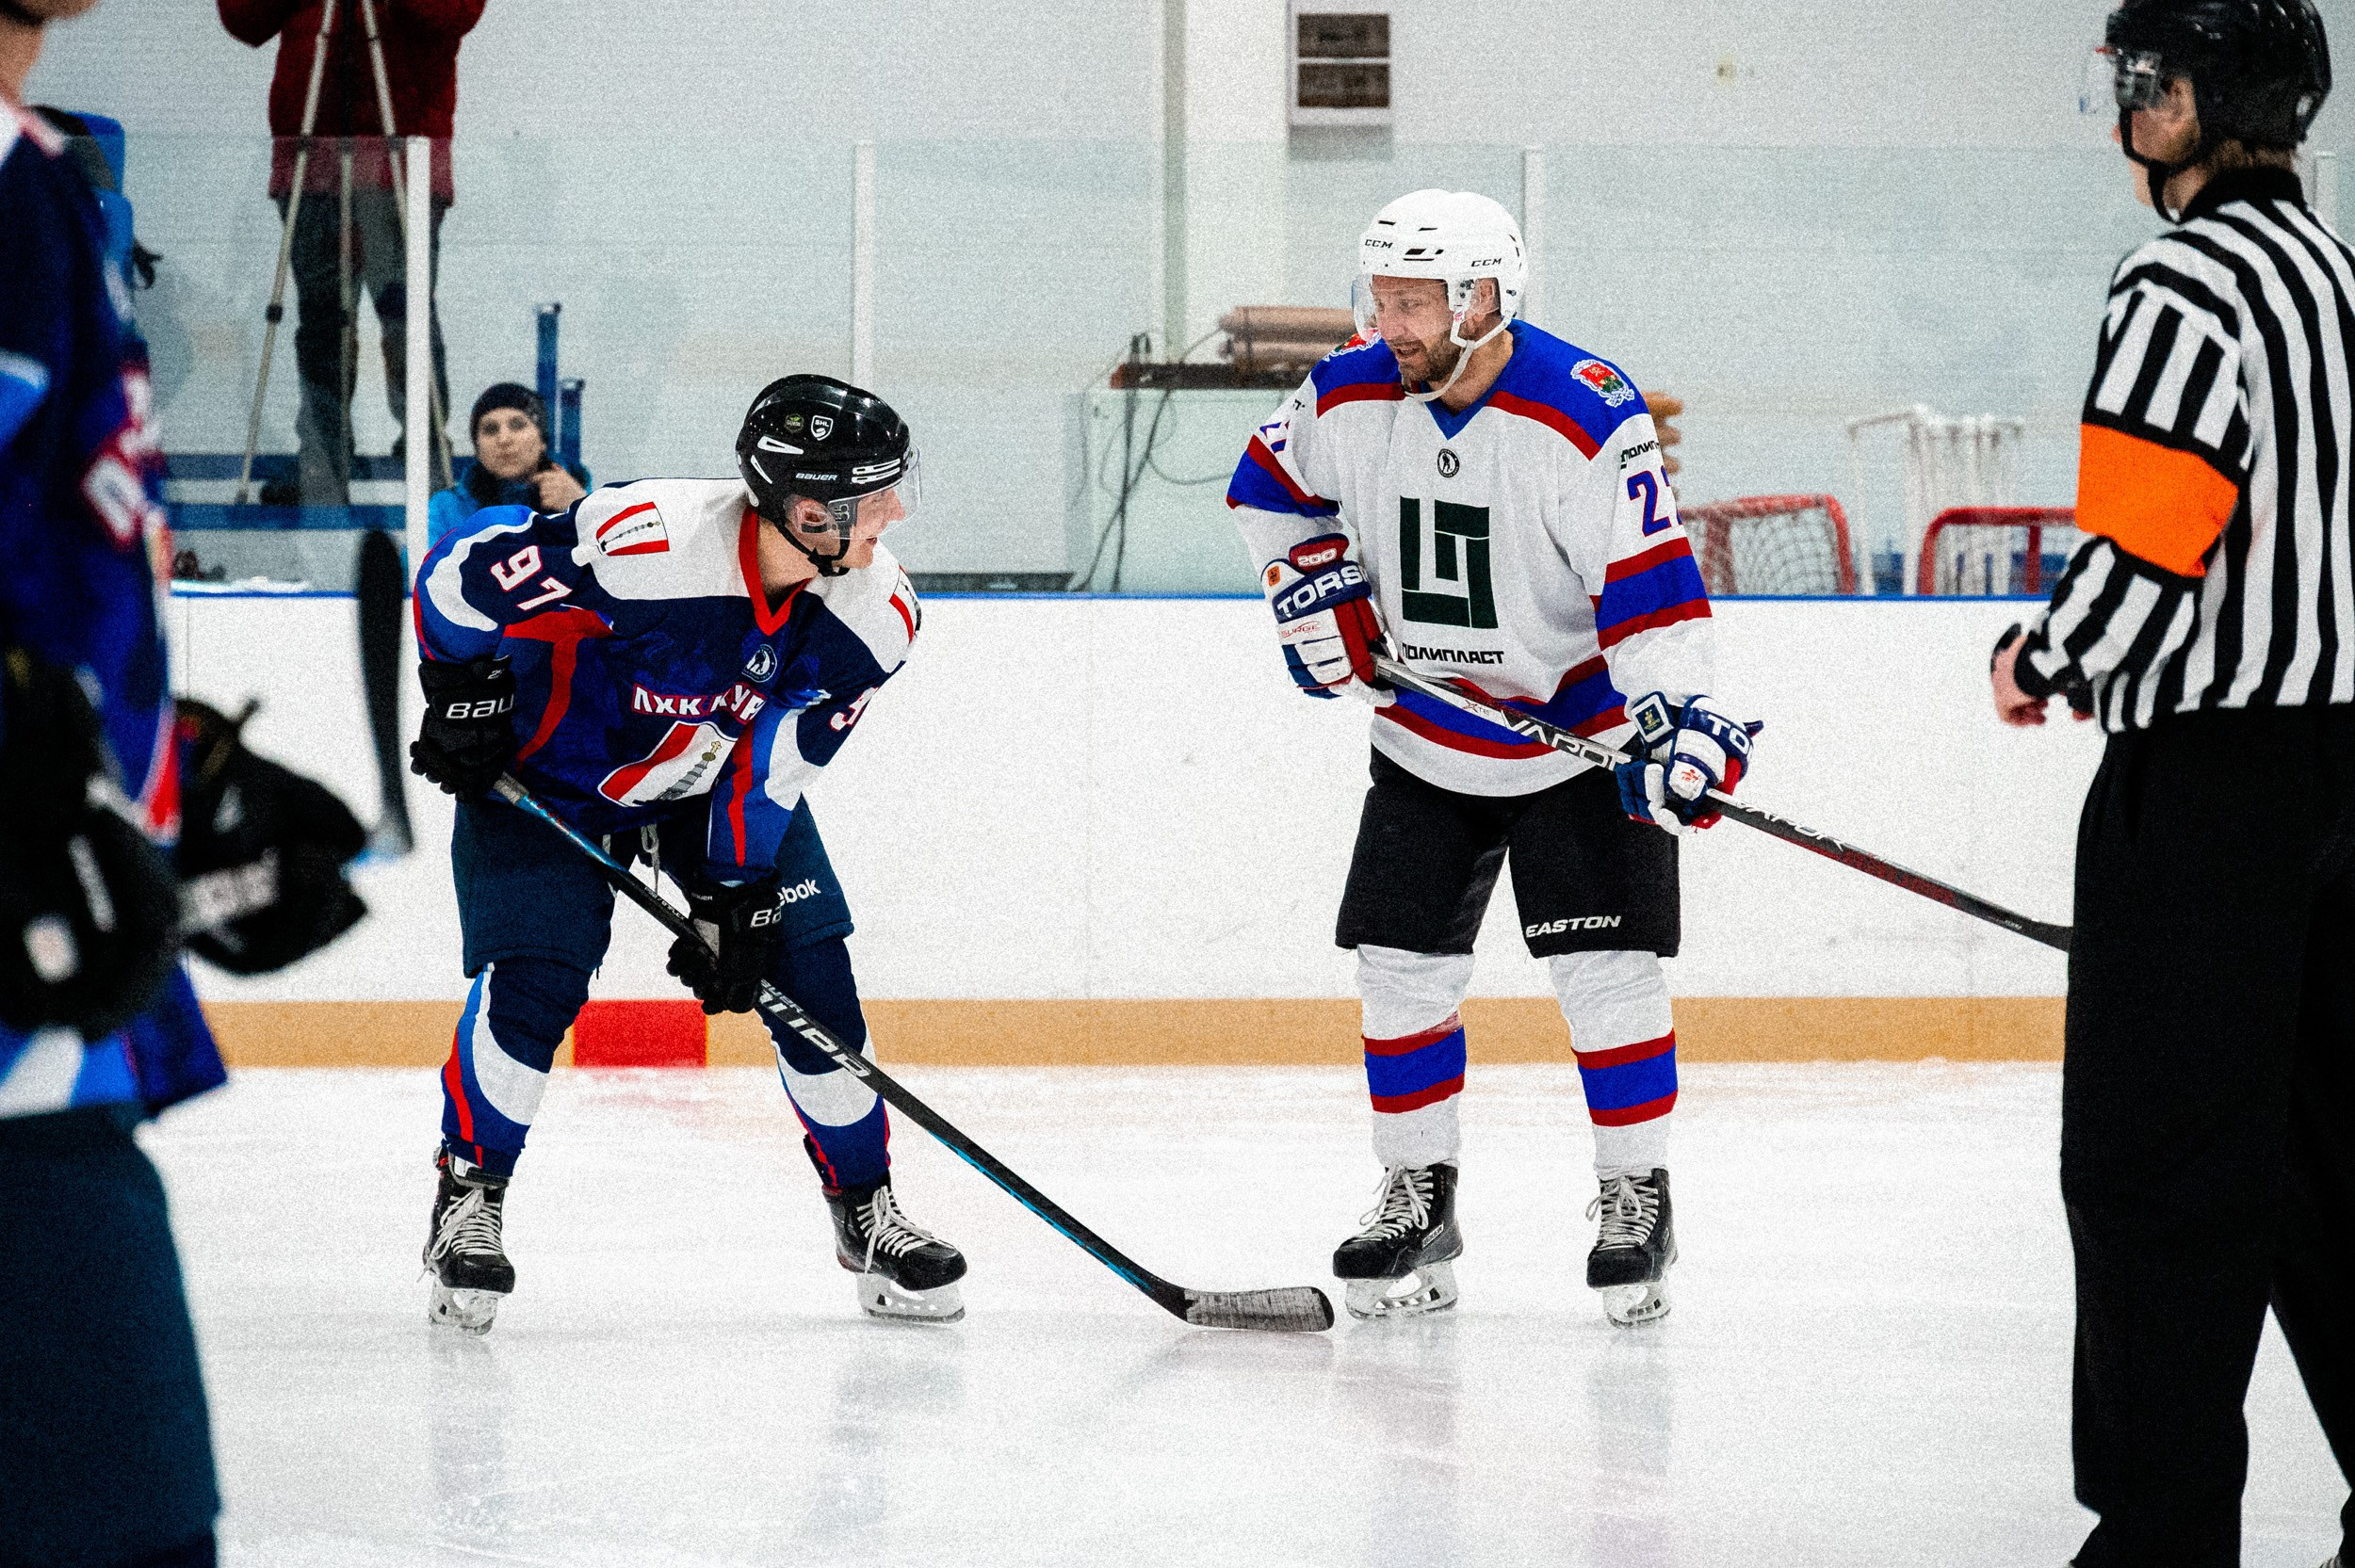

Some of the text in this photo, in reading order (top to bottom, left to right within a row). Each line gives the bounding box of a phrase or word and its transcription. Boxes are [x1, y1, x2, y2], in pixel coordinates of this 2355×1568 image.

[1364, 238, 1394, 250] CCM
[1470, 257, 1502, 268] CCM
[814, 419, 830, 428] SHL
[795, 473, 837, 481] BAUER
[1627, 464, 1682, 538] 2
[490, 544, 573, 611] 97
[1402, 642, 1505, 665] ПОЛИПЛАСТ
[1525, 915, 1622, 938] EASTON
